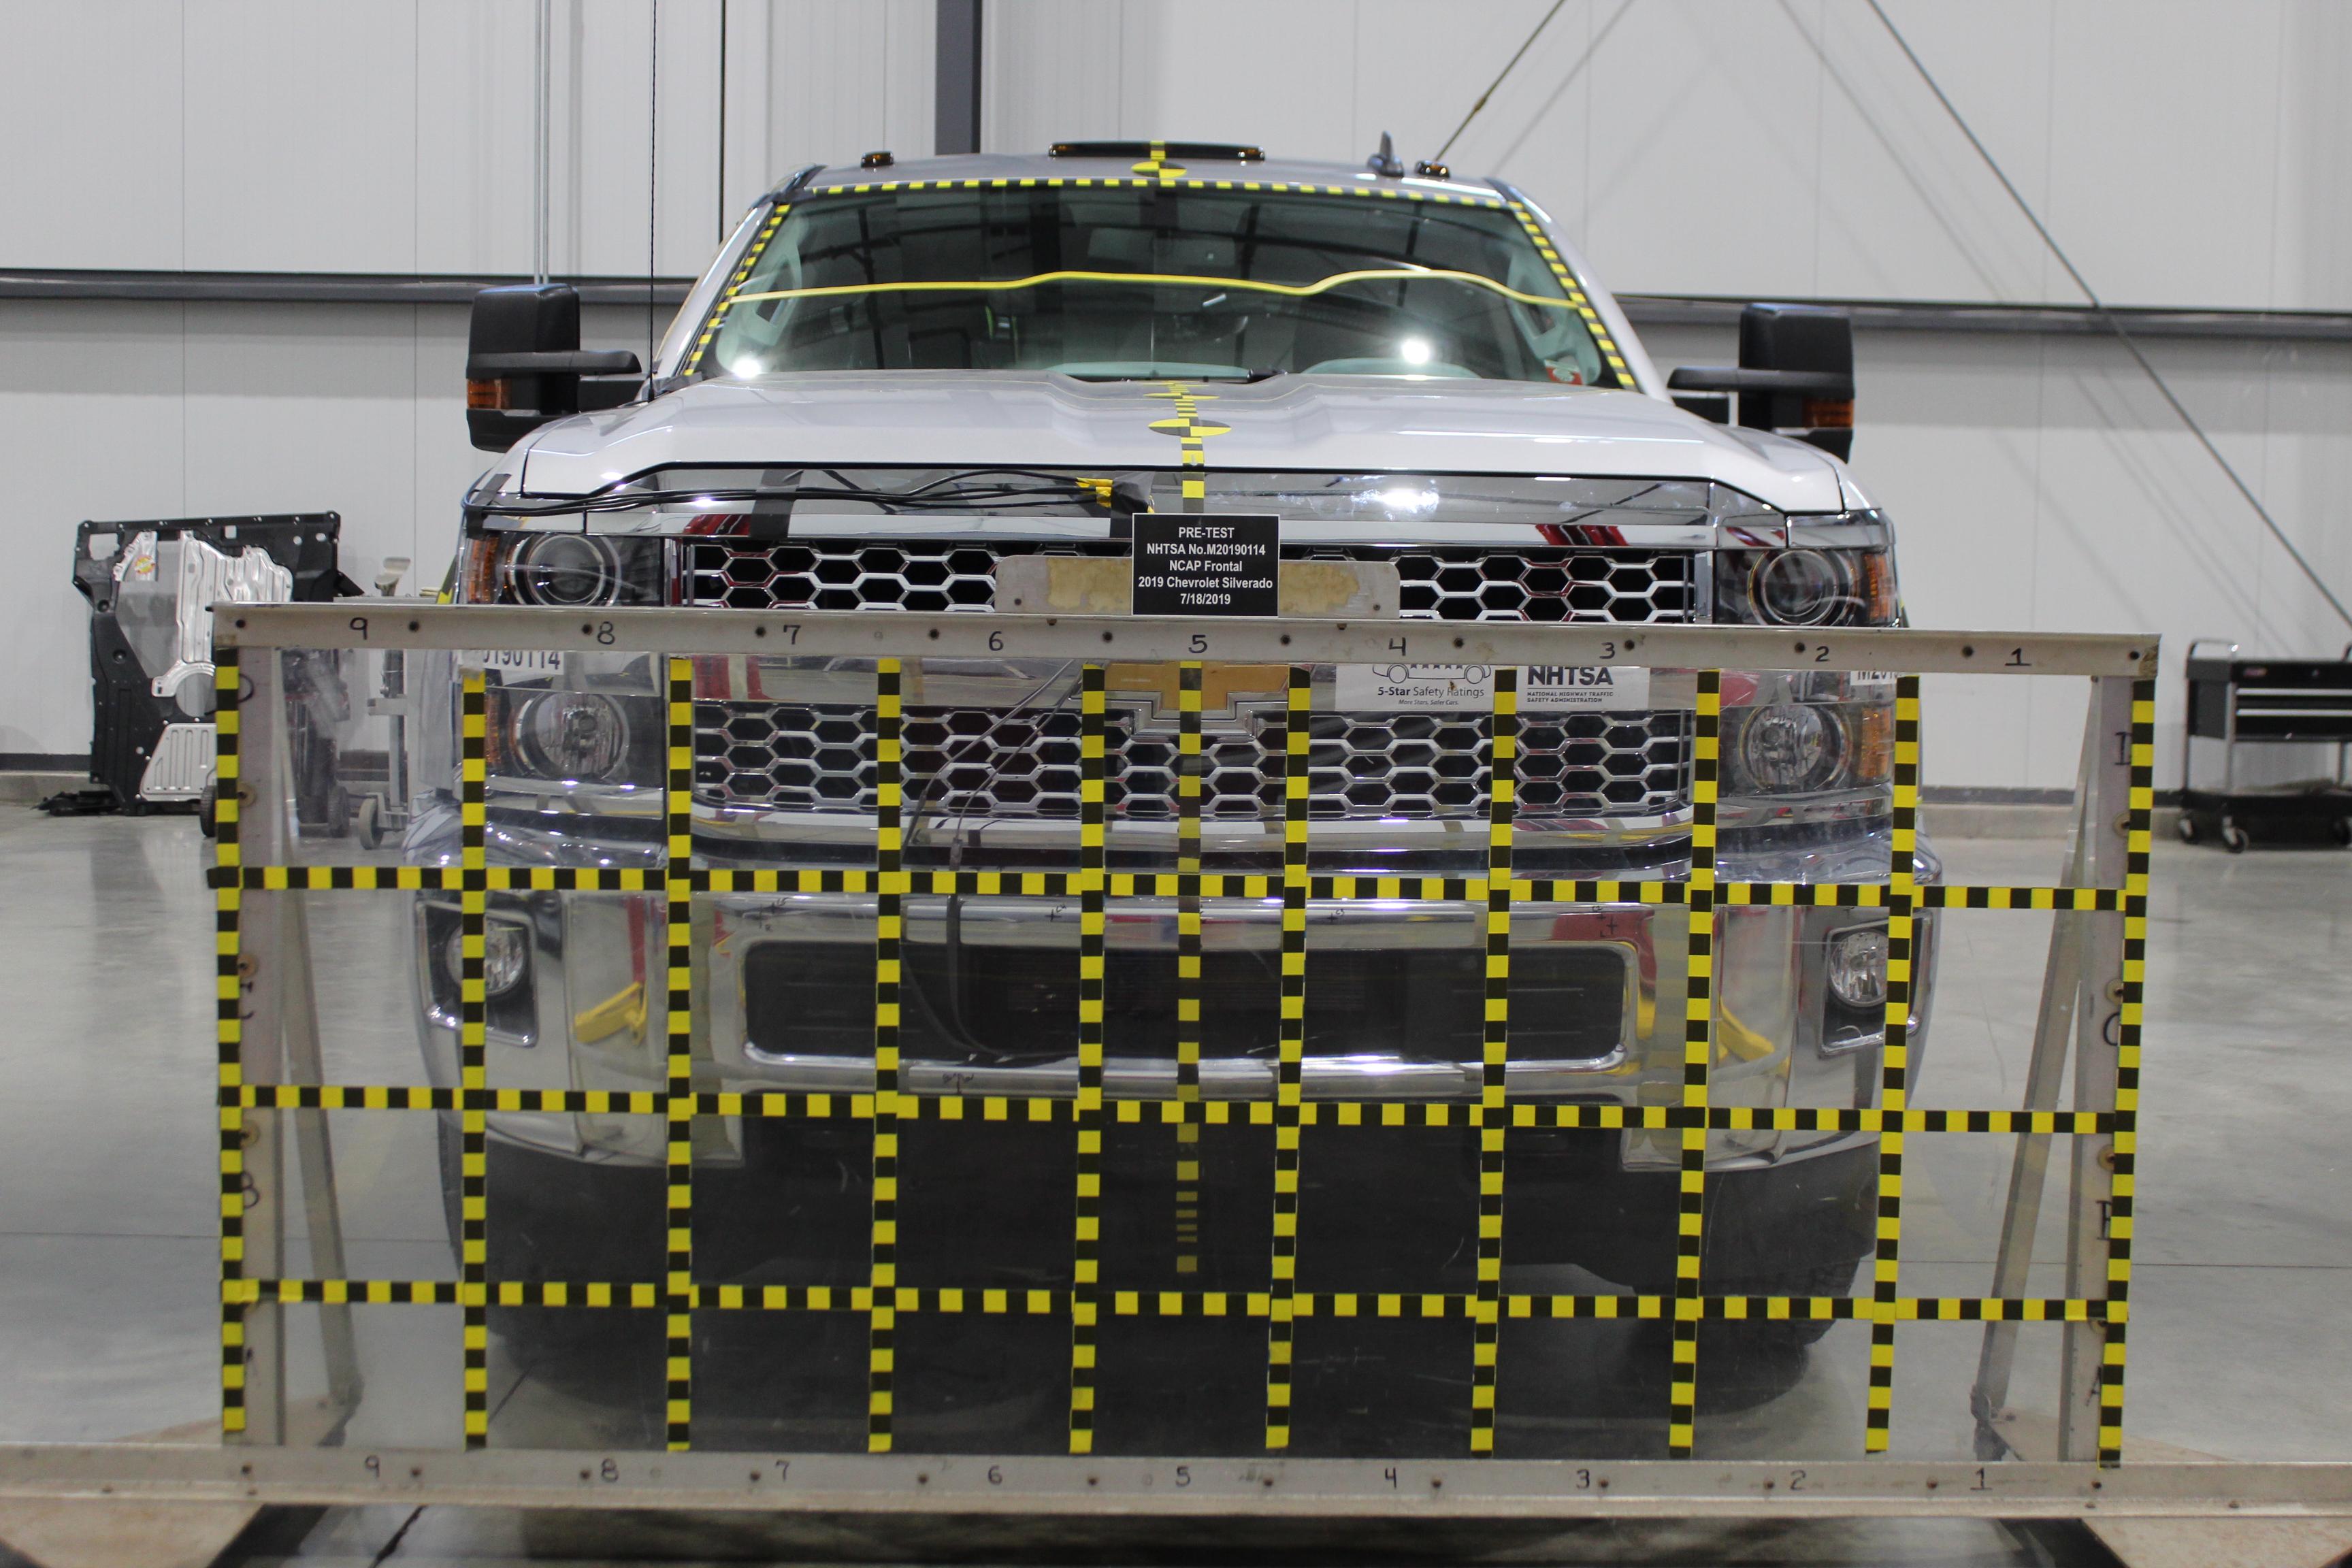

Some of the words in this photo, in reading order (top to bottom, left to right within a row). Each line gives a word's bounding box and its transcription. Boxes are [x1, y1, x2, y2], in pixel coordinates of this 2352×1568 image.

[1178, 527, 1235, 538] PRE-TEST
[1147, 543, 1186, 555] NHTSA
[1188, 544, 1266, 555] No.M20190114
[1169, 560, 1202, 572] NCAP
[1204, 560, 1243, 572] Frontal
[1138, 576, 1164, 587] 2019
[1166, 576, 1220, 588] Chevrolet
[1222, 576, 1273, 589] Silverado
[1180, 593, 1231, 605] 7/18/2019
[349, 617, 368, 640] 9
[597, 621, 615, 645] 8
[783, 624, 802, 645] 7
[988, 630, 1004, 651] 6
[1188, 634, 1208, 654] 5
[1388, 636, 1407, 656] 4
[1599, 642, 1616, 659] 3
[1815, 645, 1829, 662] 2
[2005, 647, 2031, 666] 1
[1527, 666, 1614, 686] NHTSA
[1377, 687, 1411, 696] 5-Star
[1413, 687, 1444, 698] Safety
[1447, 687, 1484, 698] Ratings
[364, 1455, 380, 1477] 9
[601, 1458, 619, 1482] 8
[775, 1459, 790, 1482] 7
[987, 1465, 1002, 1485] 6
[1175, 1465, 1191, 1486] 5
[1384, 1467, 1397, 1488] 4
[1576, 1469, 1590, 1488] 3
[1790, 1469, 1806, 1490] 2
[1970, 1467, 1993, 1490] 1
